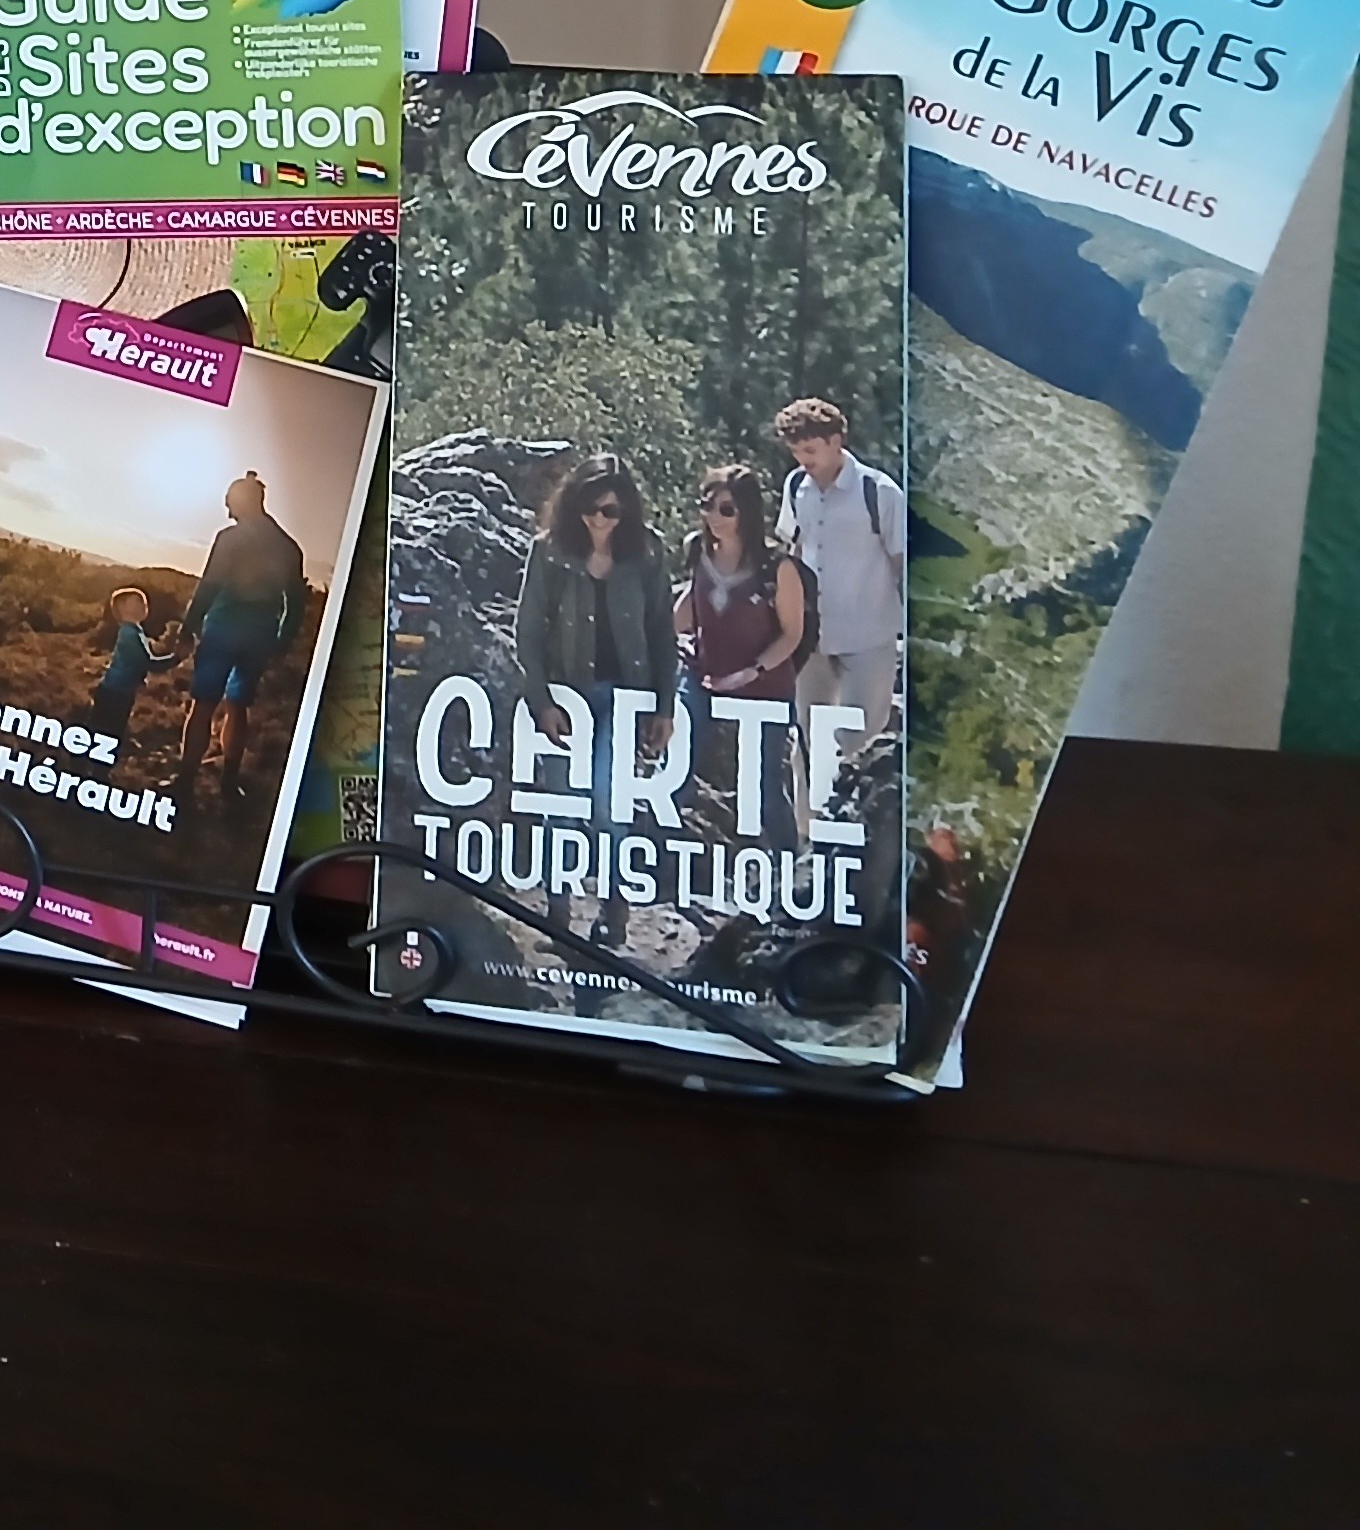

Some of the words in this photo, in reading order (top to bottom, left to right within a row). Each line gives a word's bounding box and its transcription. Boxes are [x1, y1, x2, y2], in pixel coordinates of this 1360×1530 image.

[19, 32, 209, 97] Sites
[908, 95, 984, 138] RQUE
[991, 124, 1031, 154] DE
[1037, 141, 1218, 219] NAVACELLES
[65, 207, 154, 230] ARDÈCHE
[167, 210, 276, 229] CAMARGUE
[290, 206, 395, 227] CÉVENNES
[522, 202, 767, 235] TOURISME
[416, 675, 865, 846] CARTE
[413, 814, 862, 926] TOURISTIQUE
